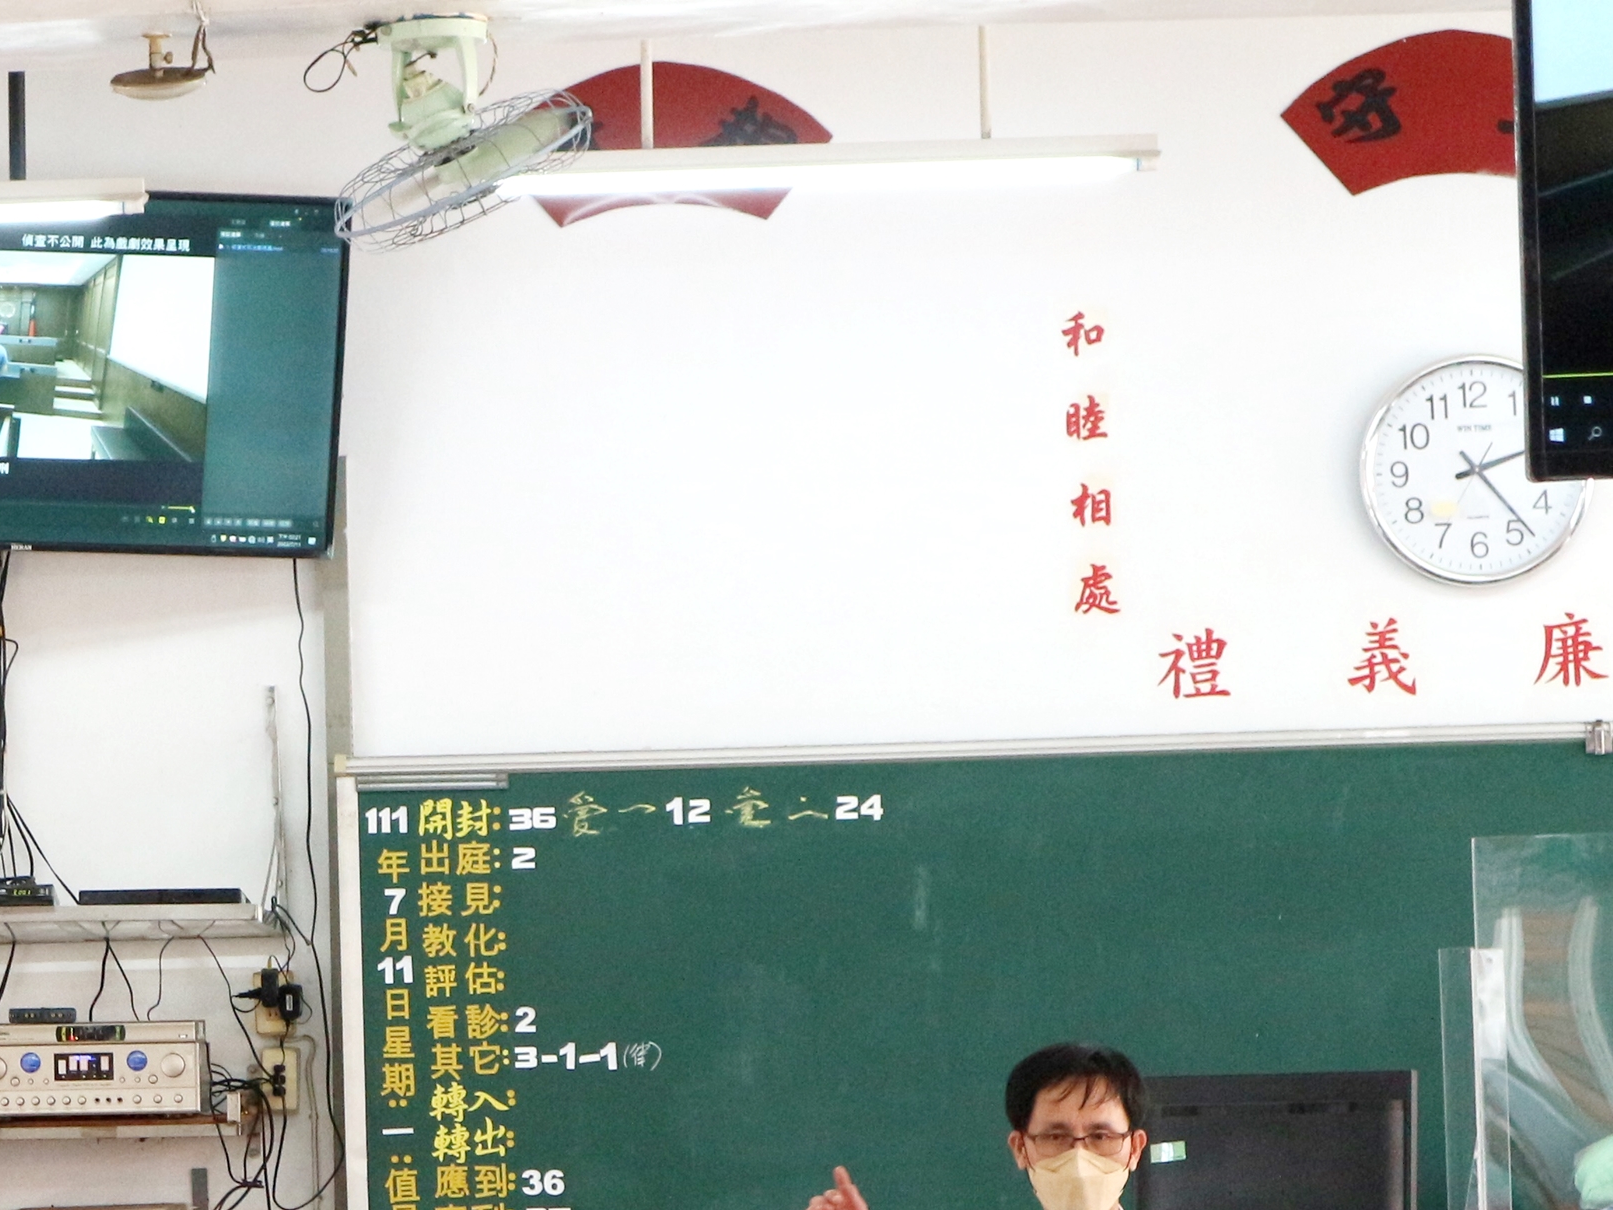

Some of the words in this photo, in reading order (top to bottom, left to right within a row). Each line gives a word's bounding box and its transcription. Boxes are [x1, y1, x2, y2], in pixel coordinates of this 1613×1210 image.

[1426, 394, 1451, 420] 11
[1457, 381, 1488, 409] 12
[1398, 423, 1430, 450] 10
[1061, 311, 1121, 615] 和睦相處
[1389, 462, 1409, 487] 9
[1404, 498, 1424, 524] 8
[1532, 490, 1552, 515] 4
[1435, 522, 1452, 549] 7
[1470, 532, 1489, 558] 6
[1505, 519, 1525, 546] 5
[508, 807, 556, 832] 36
[665, 797, 711, 825] 12
[836, 794, 884, 821] 24
[511, 847, 537, 870] 2
[514, 1006, 537, 1034] 2
[521, 1169, 565, 1196] 36
